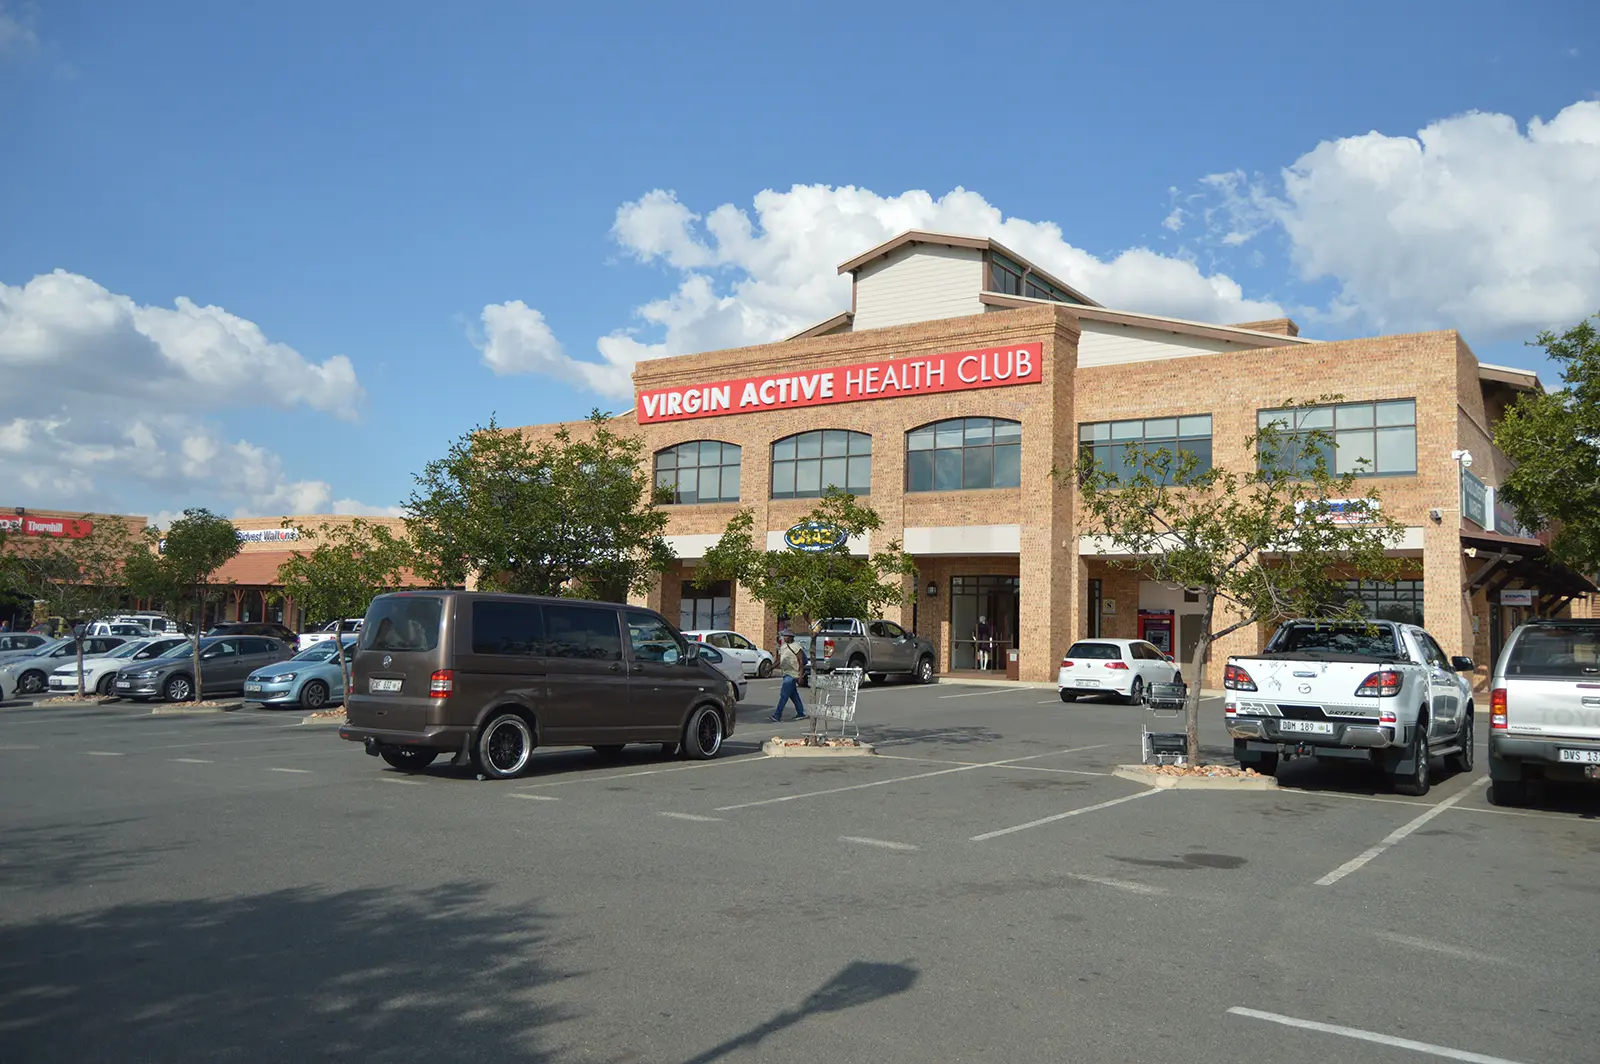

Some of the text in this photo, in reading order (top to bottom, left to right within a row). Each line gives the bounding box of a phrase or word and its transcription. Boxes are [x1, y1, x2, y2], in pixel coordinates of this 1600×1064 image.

[642, 349, 1033, 418] VIRGIN ACTIVE HEALTH CLUB
[28, 521, 63, 533] Thornhill
[263, 529, 297, 541] Waltons
[1300, 722, 1314, 732] 189
[1325, 725, 1331, 733] L
[1563, 750, 1581, 761] DVS
